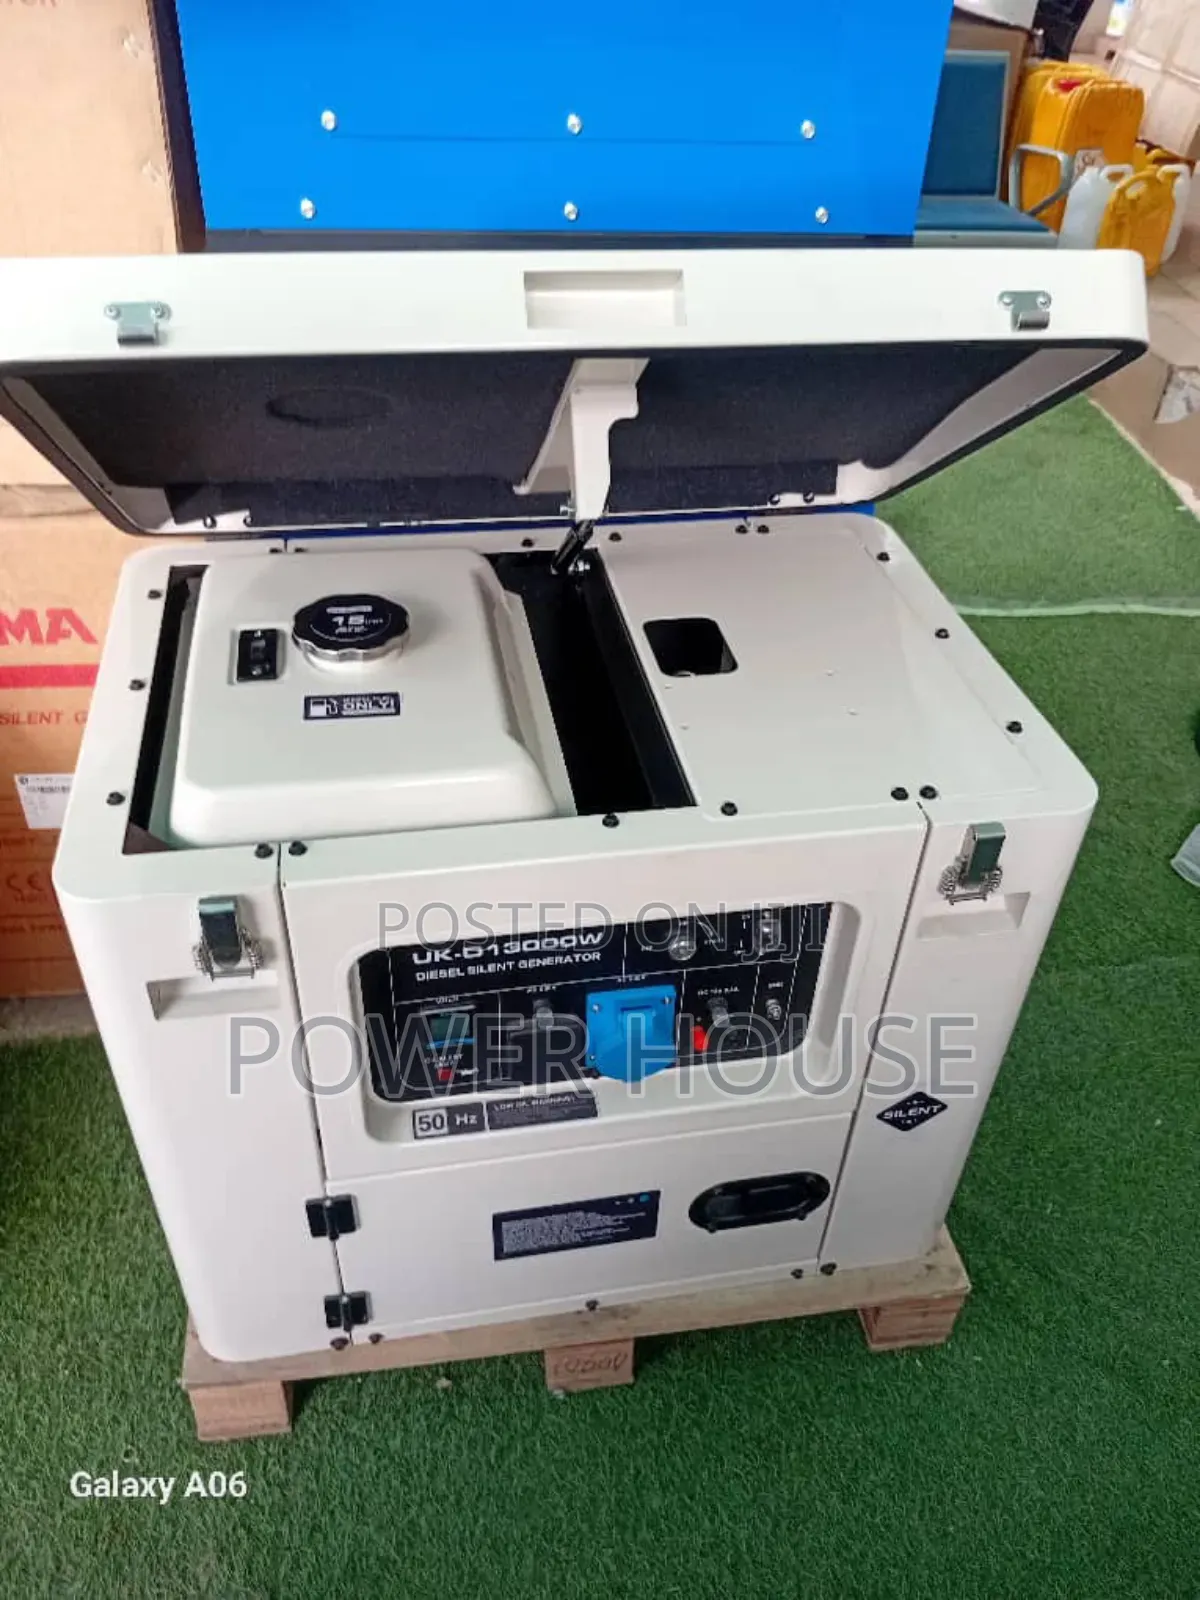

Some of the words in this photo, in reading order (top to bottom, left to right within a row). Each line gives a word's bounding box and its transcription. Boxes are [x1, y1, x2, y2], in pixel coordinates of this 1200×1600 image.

[415, 967, 465, 982] DIESEL
[467, 960, 515, 975] SILENT
[518, 952, 602, 969] GENERATOR
[883, 1104, 942, 1119] SILENT
[418, 1113, 446, 1132] 50
[455, 1113, 478, 1126] Hz
